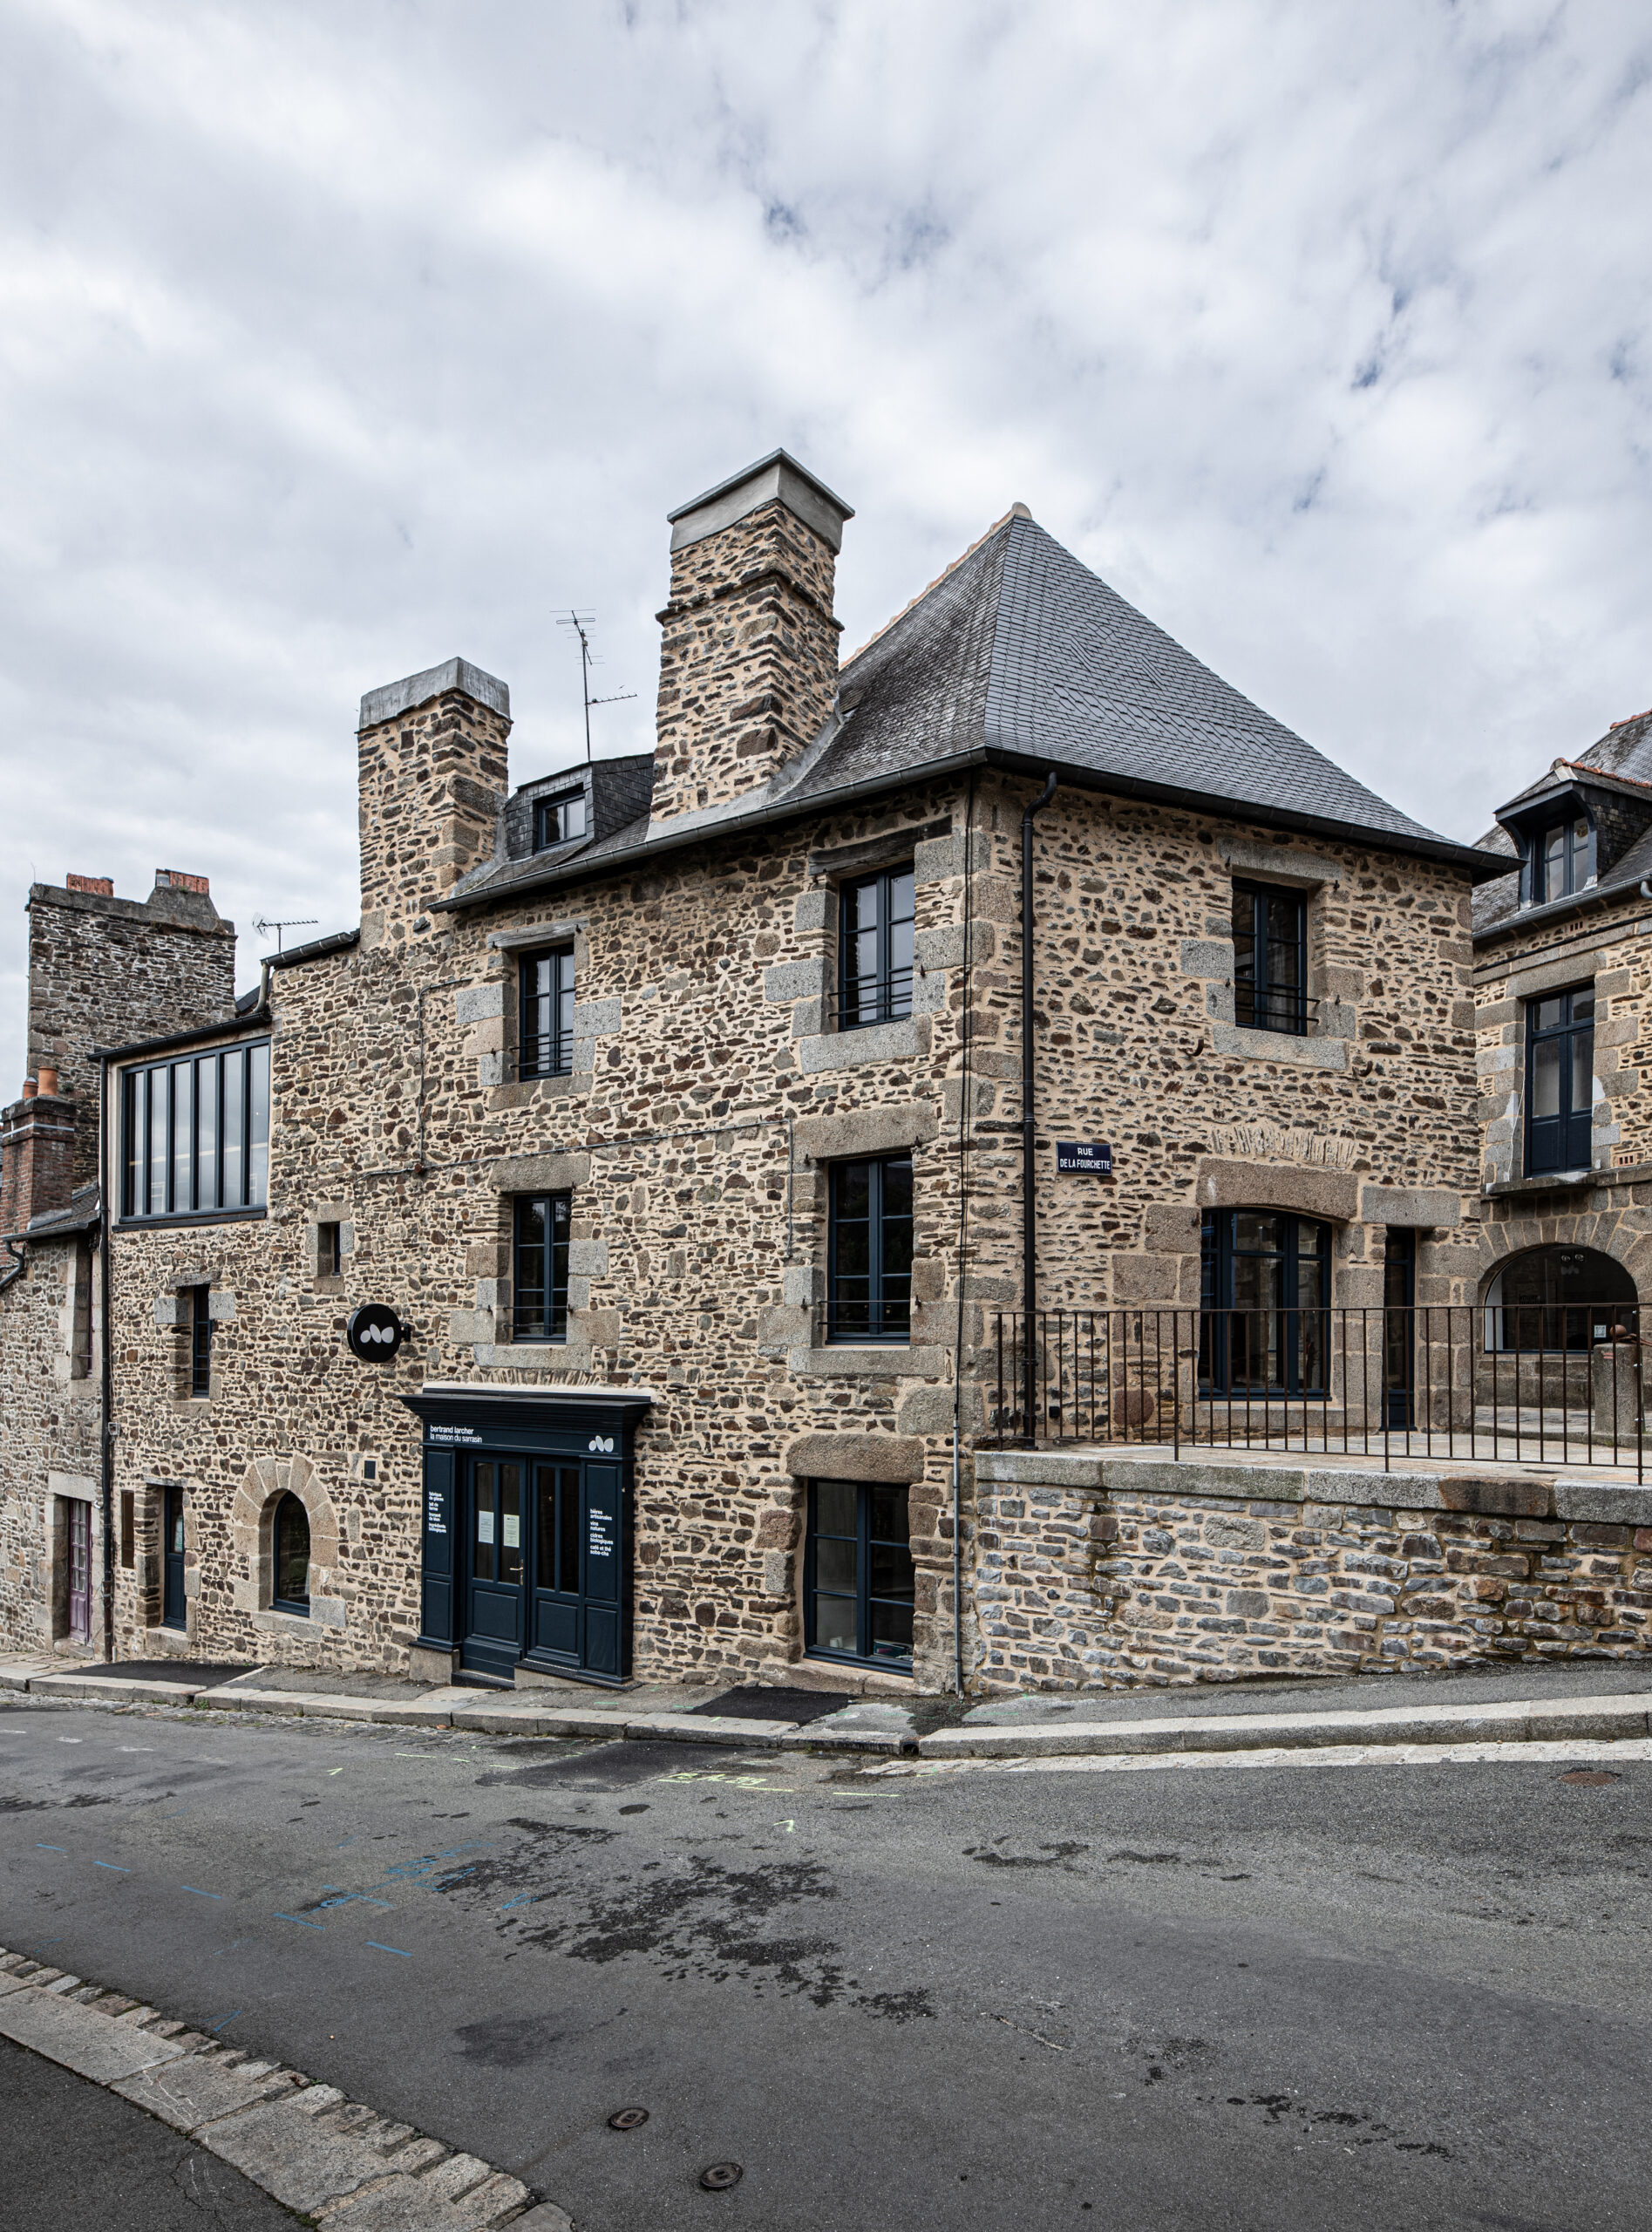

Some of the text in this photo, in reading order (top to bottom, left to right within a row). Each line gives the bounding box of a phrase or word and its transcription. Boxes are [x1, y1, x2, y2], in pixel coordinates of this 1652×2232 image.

[1077, 1147, 1094, 1156] RUE
[1059, 1158, 1111, 1170] DE LA FOURCHETTE
[430, 1425, 474, 1435] bertrand larcher
